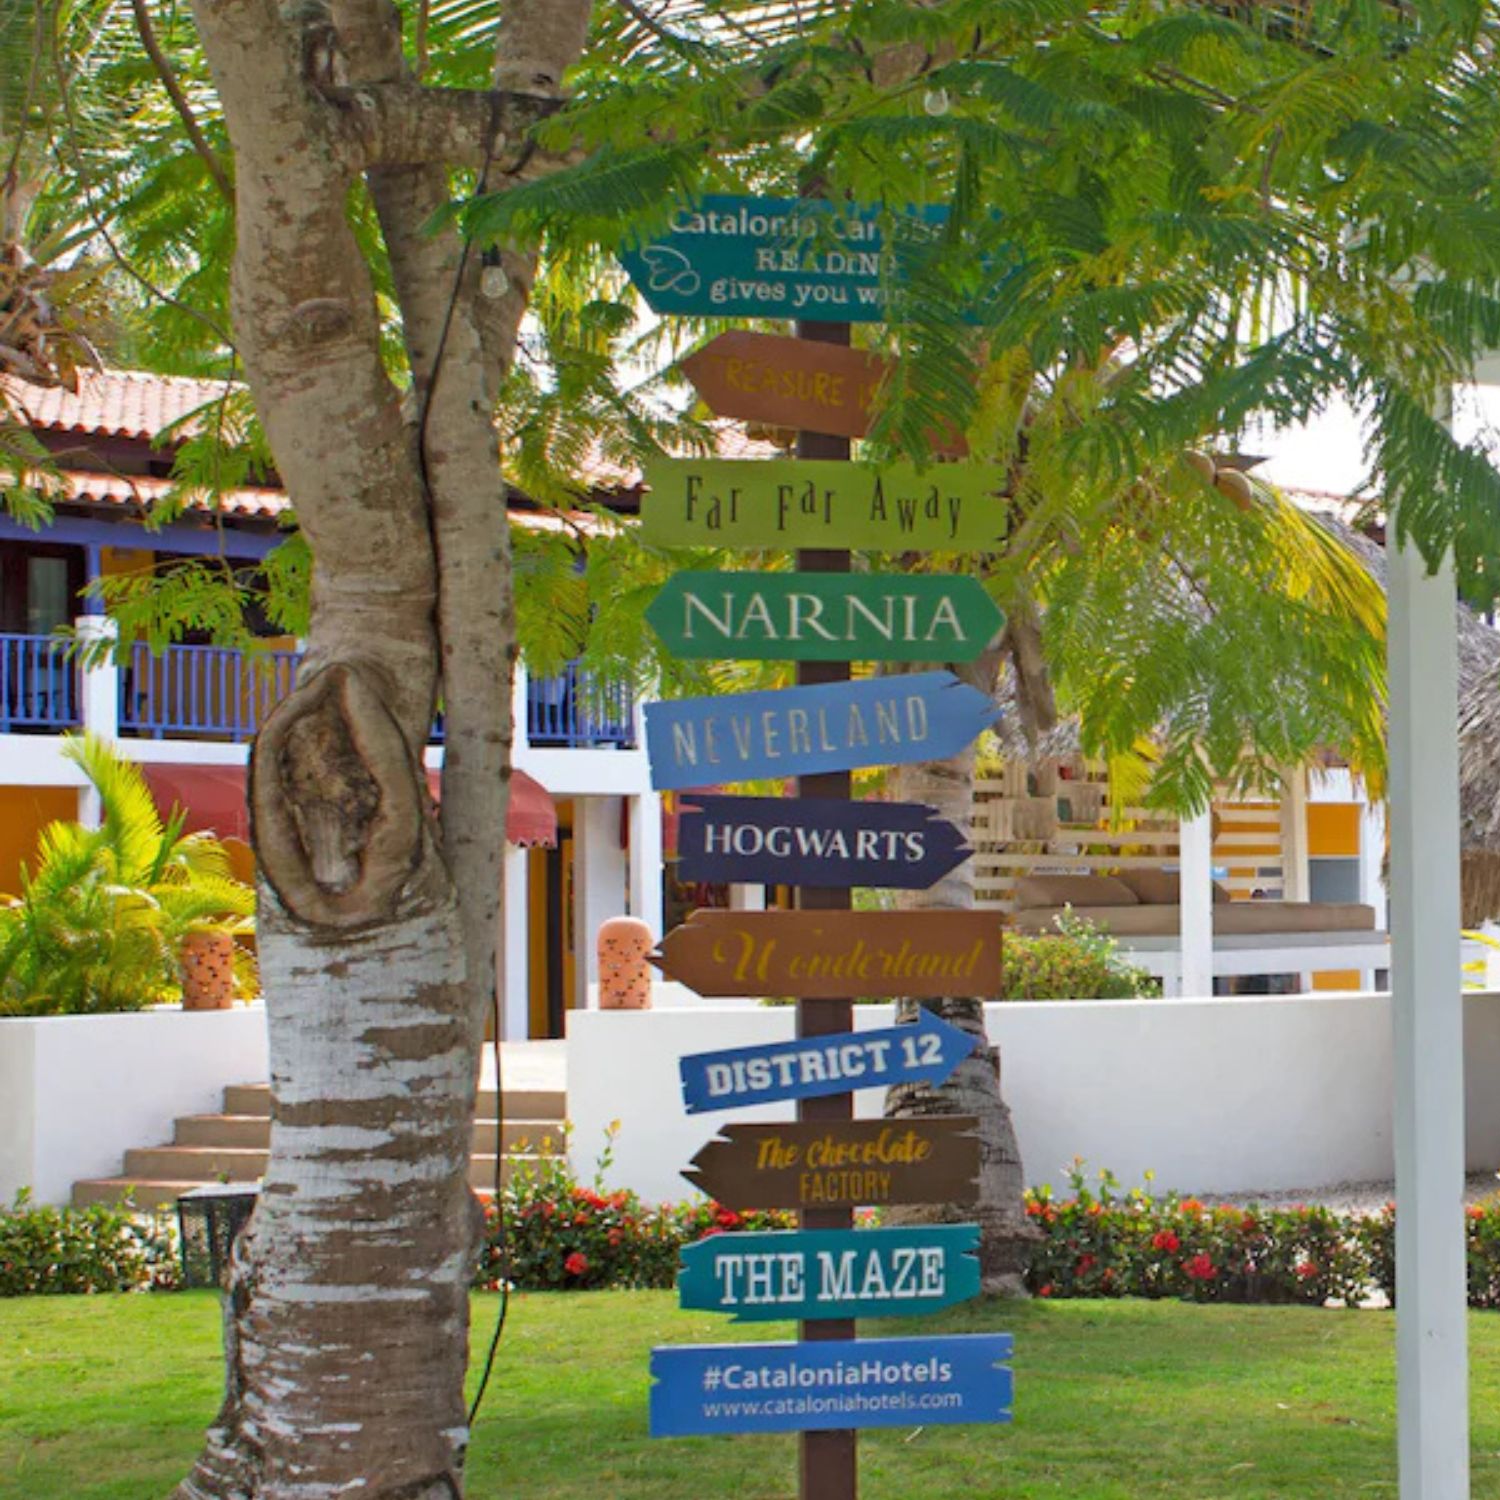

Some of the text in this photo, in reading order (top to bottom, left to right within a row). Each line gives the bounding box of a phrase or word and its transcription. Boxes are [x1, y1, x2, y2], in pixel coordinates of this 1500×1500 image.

[670, 207, 818, 238] Catalonia
[756, 248, 897, 277] READIN
[710, 279, 787, 304] gives
[793, 284, 849, 307] you
[686, 475, 962, 538] Far Far Away
[681, 591, 968, 642] NARNIA
[672, 695, 929, 767] NEVERLAND
[704, 823, 926, 863] HOGWARTS
[712, 929, 985, 982] Wonderland
[707, 1032, 944, 1097] DISTRICT 12
[755, 1128, 931, 1169] The Chocolate
[800, 1171, 892, 1201] FACTORY
[715, 1246, 945, 1305] THE MAZE
[702, 1357, 953, 1391] #CataloniaHotels
[703, 1390, 963, 1418] www.cataloniahotels.com
